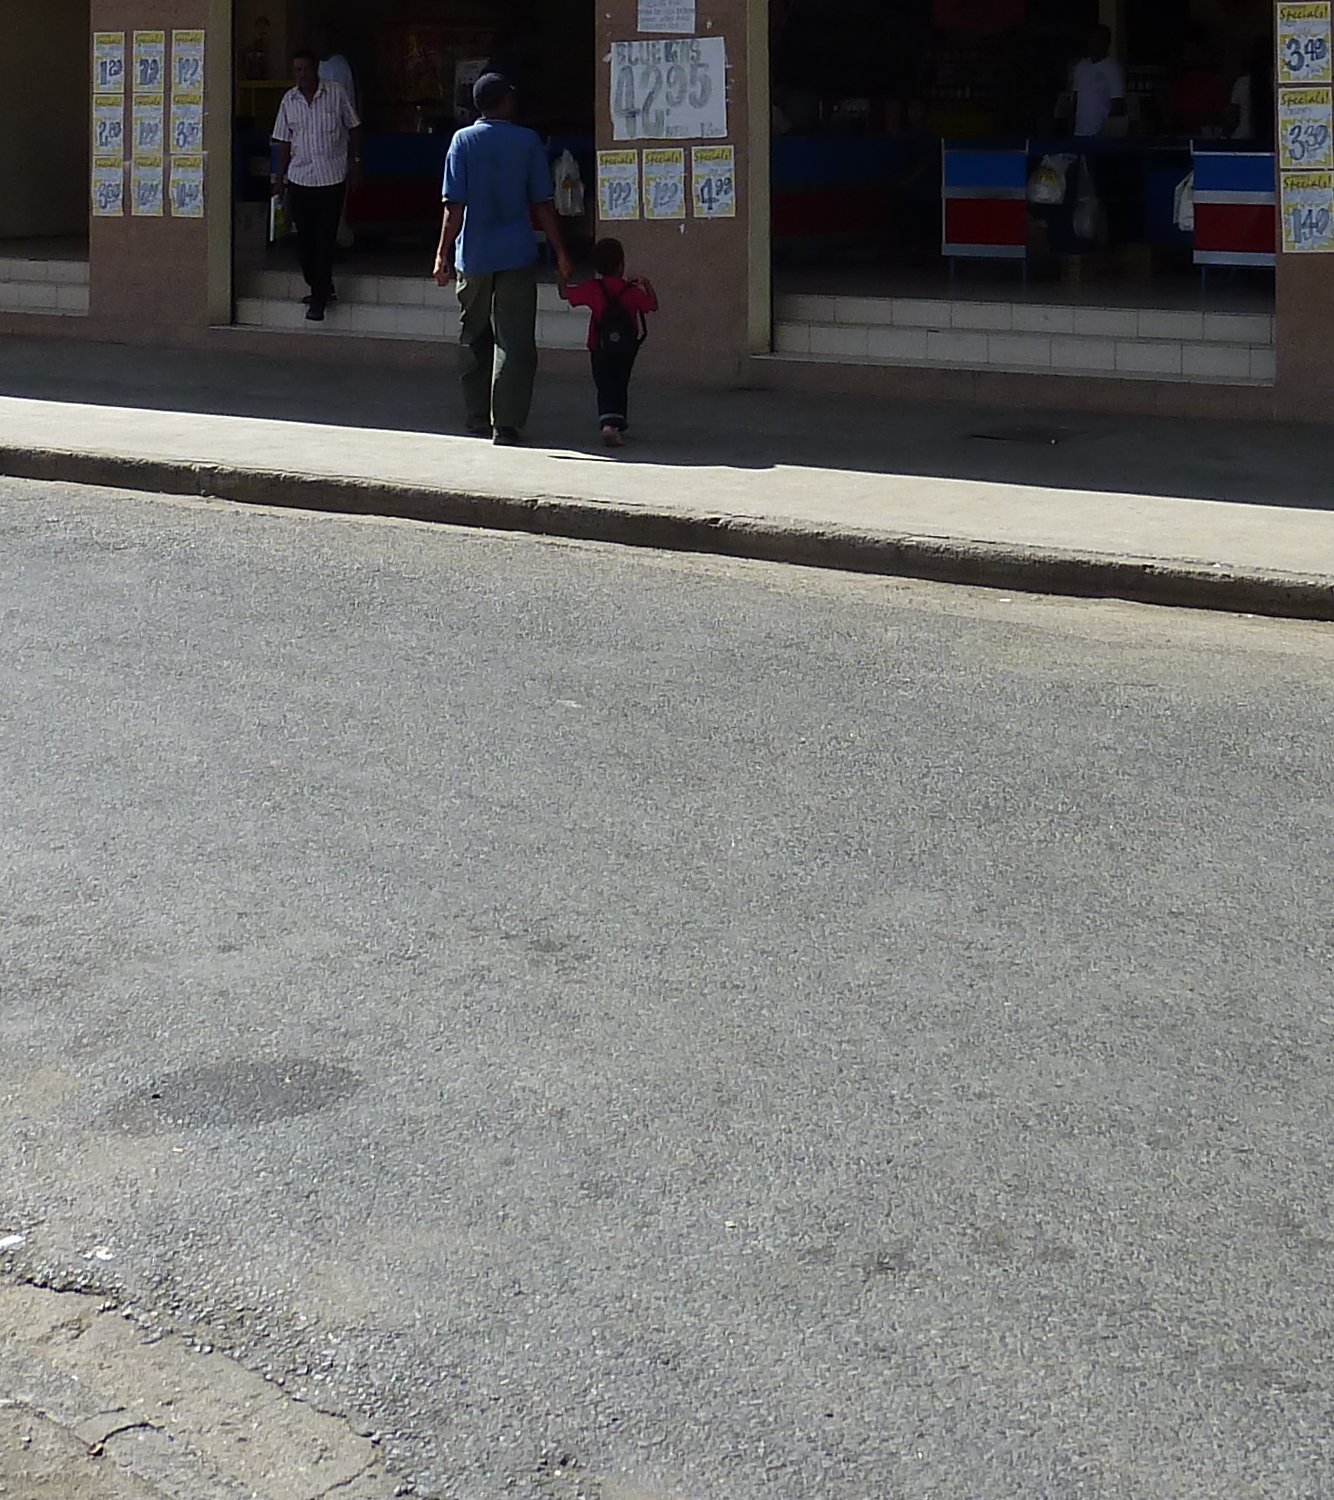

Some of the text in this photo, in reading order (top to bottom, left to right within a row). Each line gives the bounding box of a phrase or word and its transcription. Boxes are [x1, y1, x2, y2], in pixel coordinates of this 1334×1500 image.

[1279, 7, 1328, 20] Specials!
[1280, 91, 1329, 106] Specials!
[1283, 176, 1331, 190] Specials!
